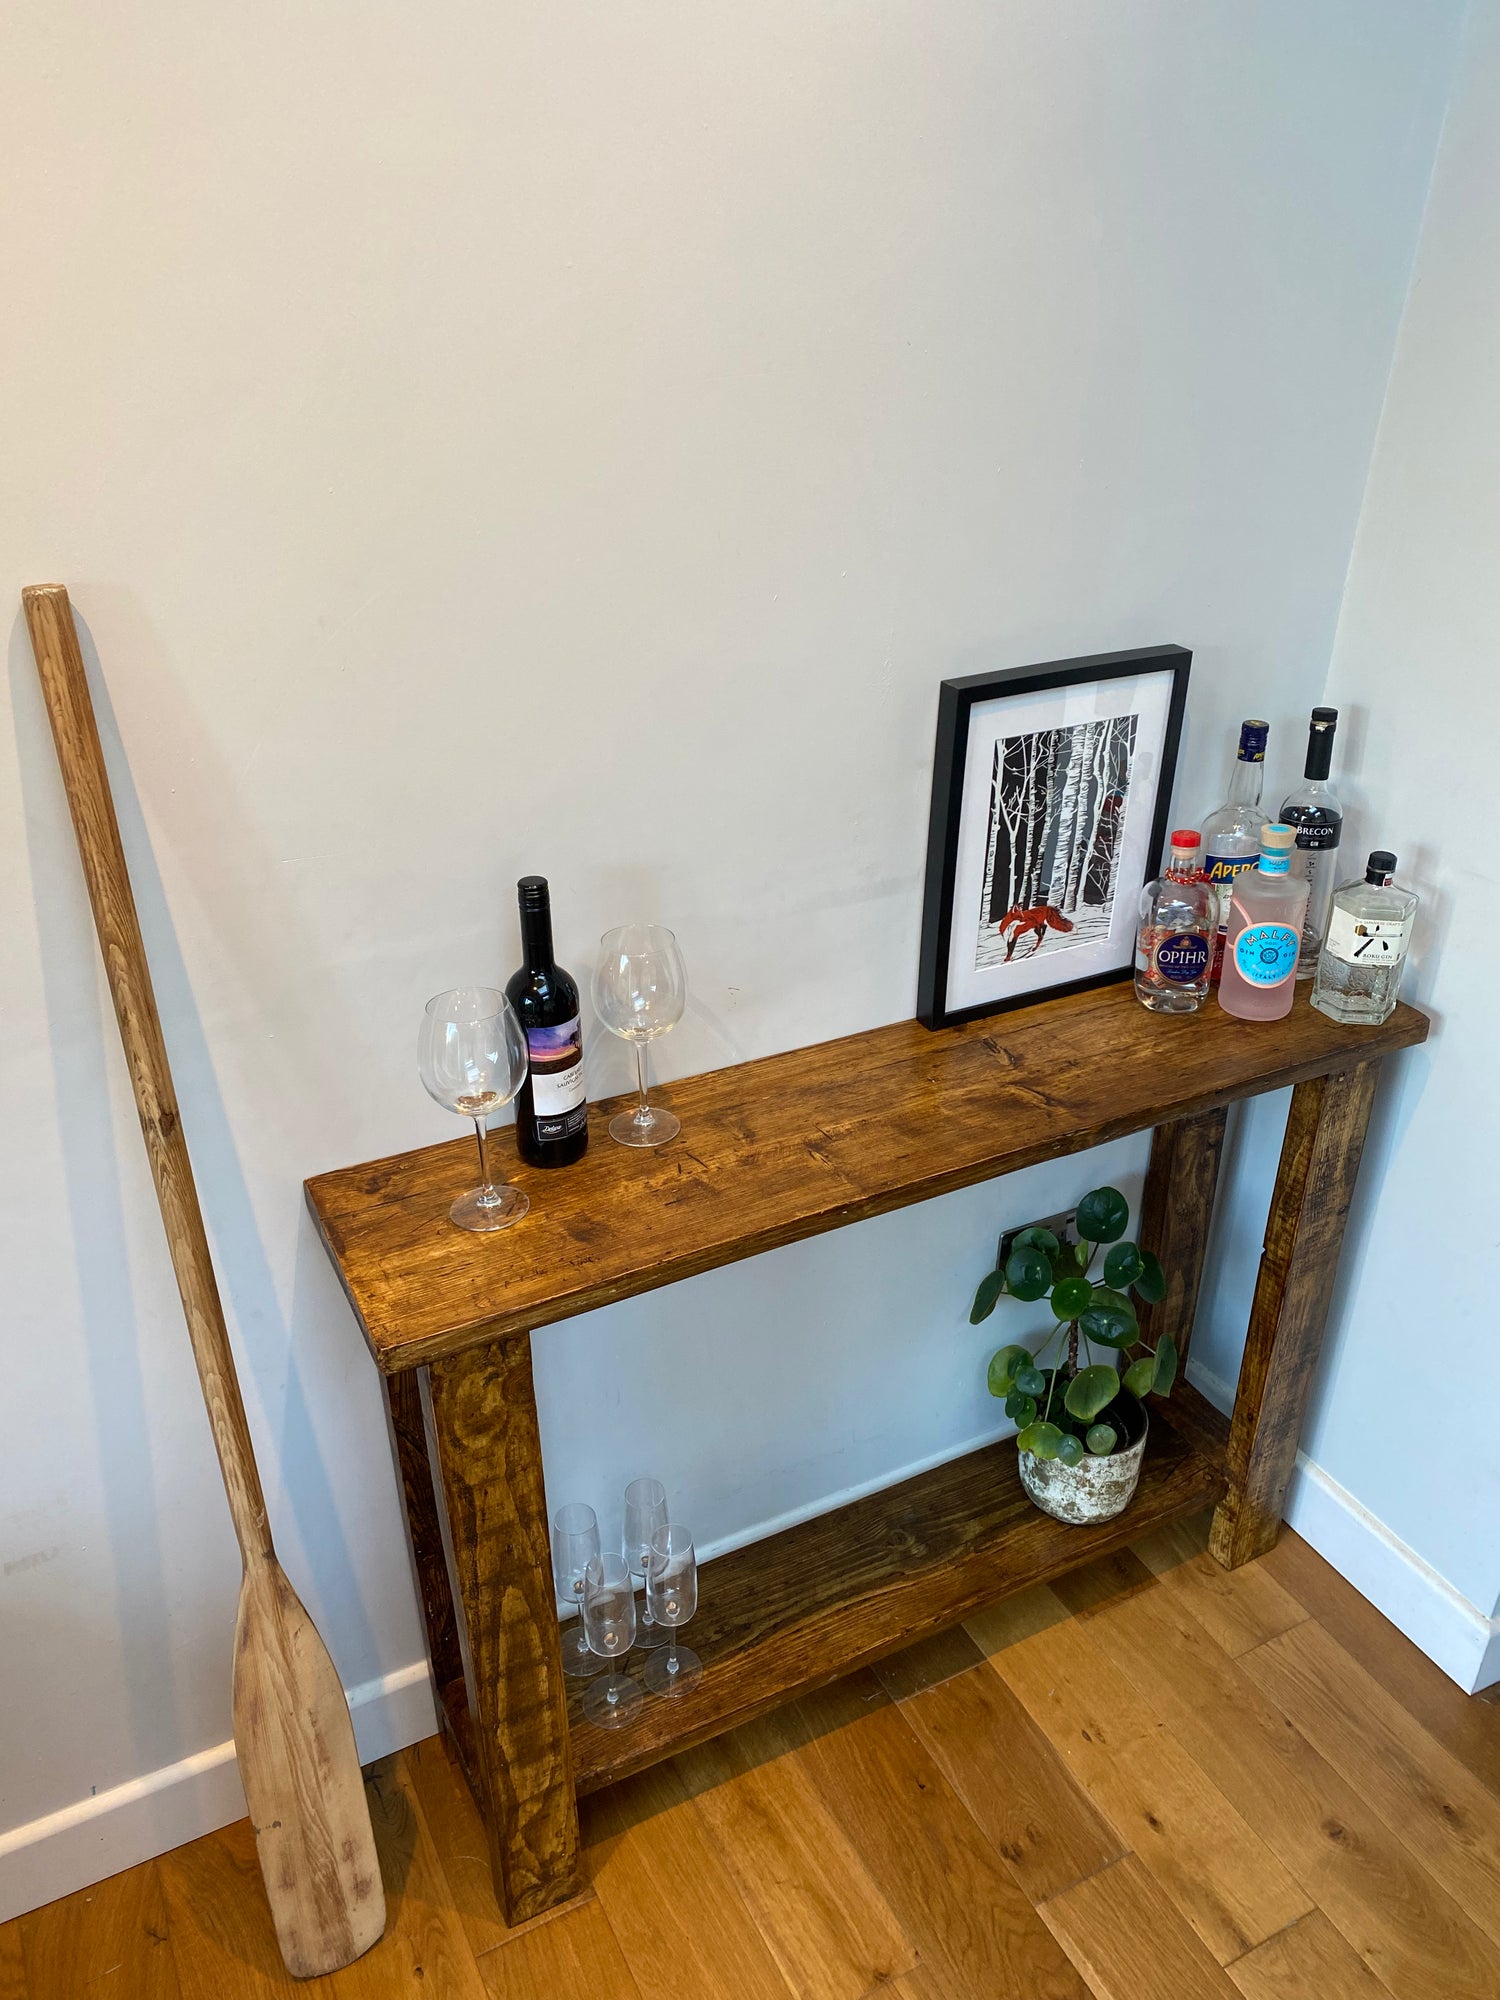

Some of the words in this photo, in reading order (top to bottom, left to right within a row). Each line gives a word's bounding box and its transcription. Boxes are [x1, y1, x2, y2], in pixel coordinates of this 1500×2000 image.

[1296, 825, 1334, 836] BRECON
[1210, 861, 1260, 879] APER
[1245, 930, 1296, 947] MALFY
[1158, 949, 1207, 964] OPIHR
[1239, 948, 1255, 956] GIN
